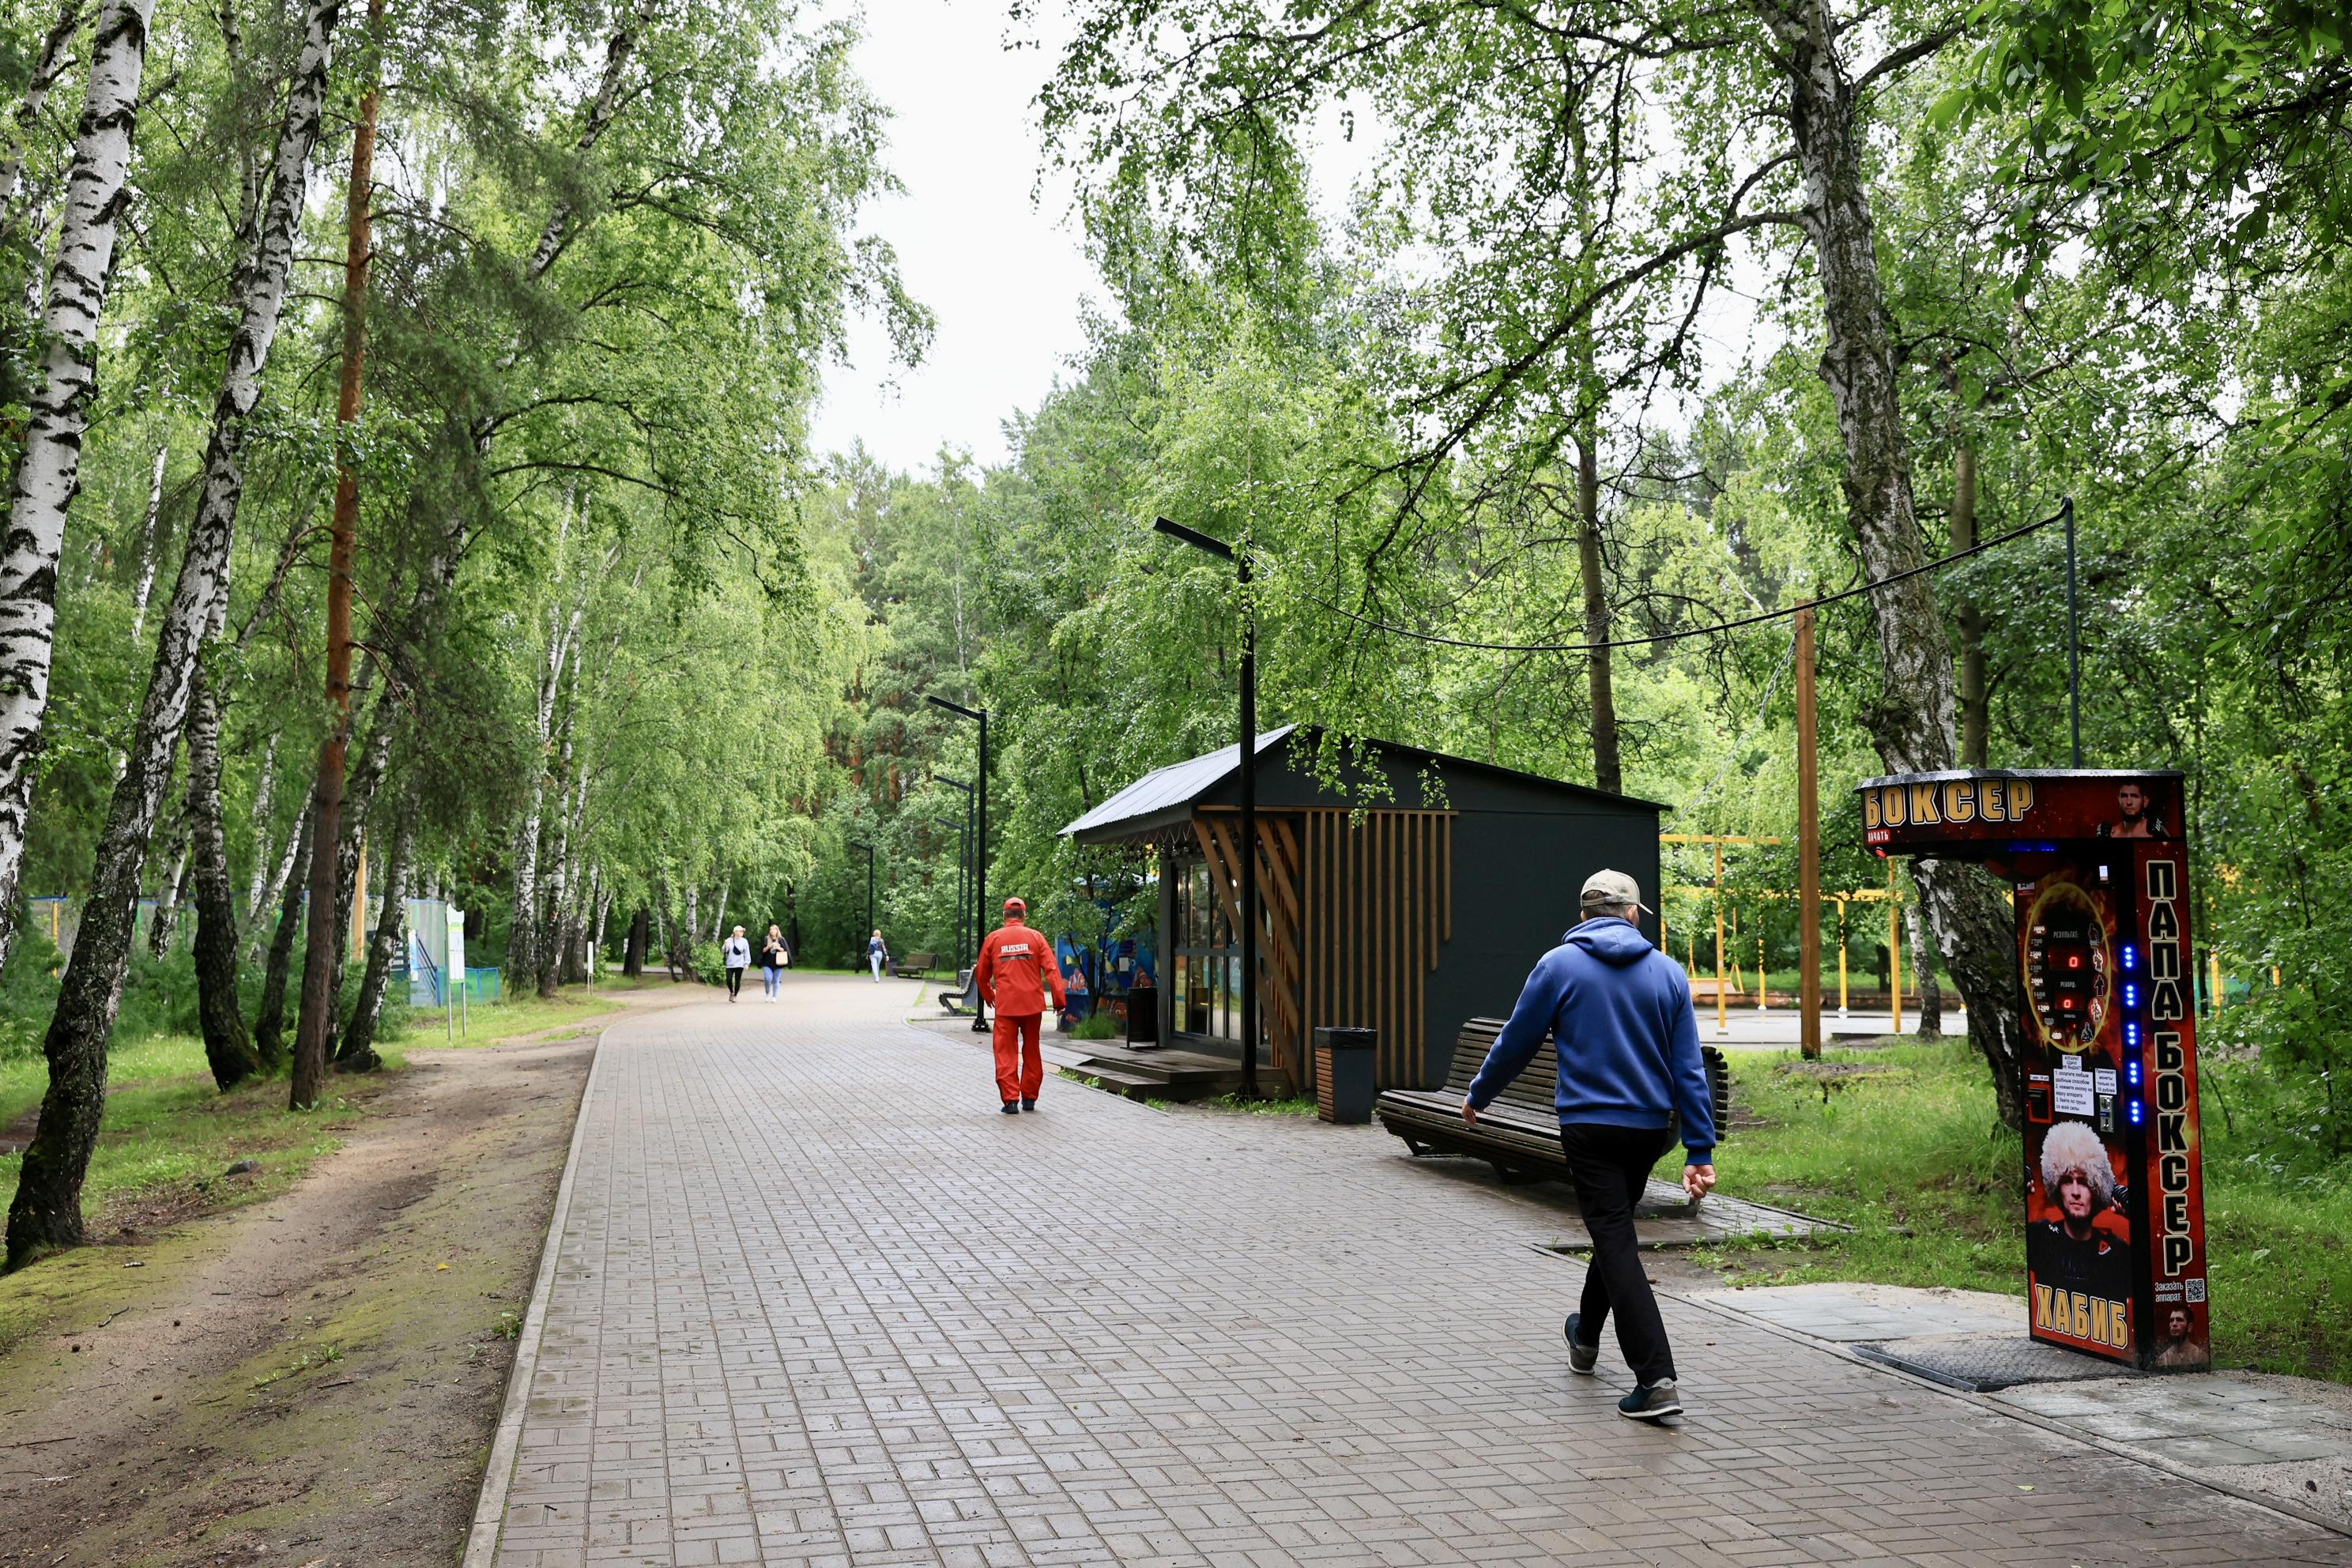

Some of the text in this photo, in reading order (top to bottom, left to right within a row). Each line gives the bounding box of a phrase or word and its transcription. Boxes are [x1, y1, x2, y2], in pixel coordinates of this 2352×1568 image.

[1865, 778, 2034, 829] БОКСЕР
[1868, 831, 1889, 842] НАЧАТЬ
[1001, 944, 1028, 953] RUSSIA
[2069, 957, 2078, 967] 0
[2064, 1000, 2071, 1008] 0
[2147, 860, 2192, 1276] ПАПА БОКСЕР
[2154, 1281, 2184, 1291] Заказать
[2155, 1293, 2182, 1302] аппарат:
[2035, 1283, 2128, 1350] ХАБИБ
